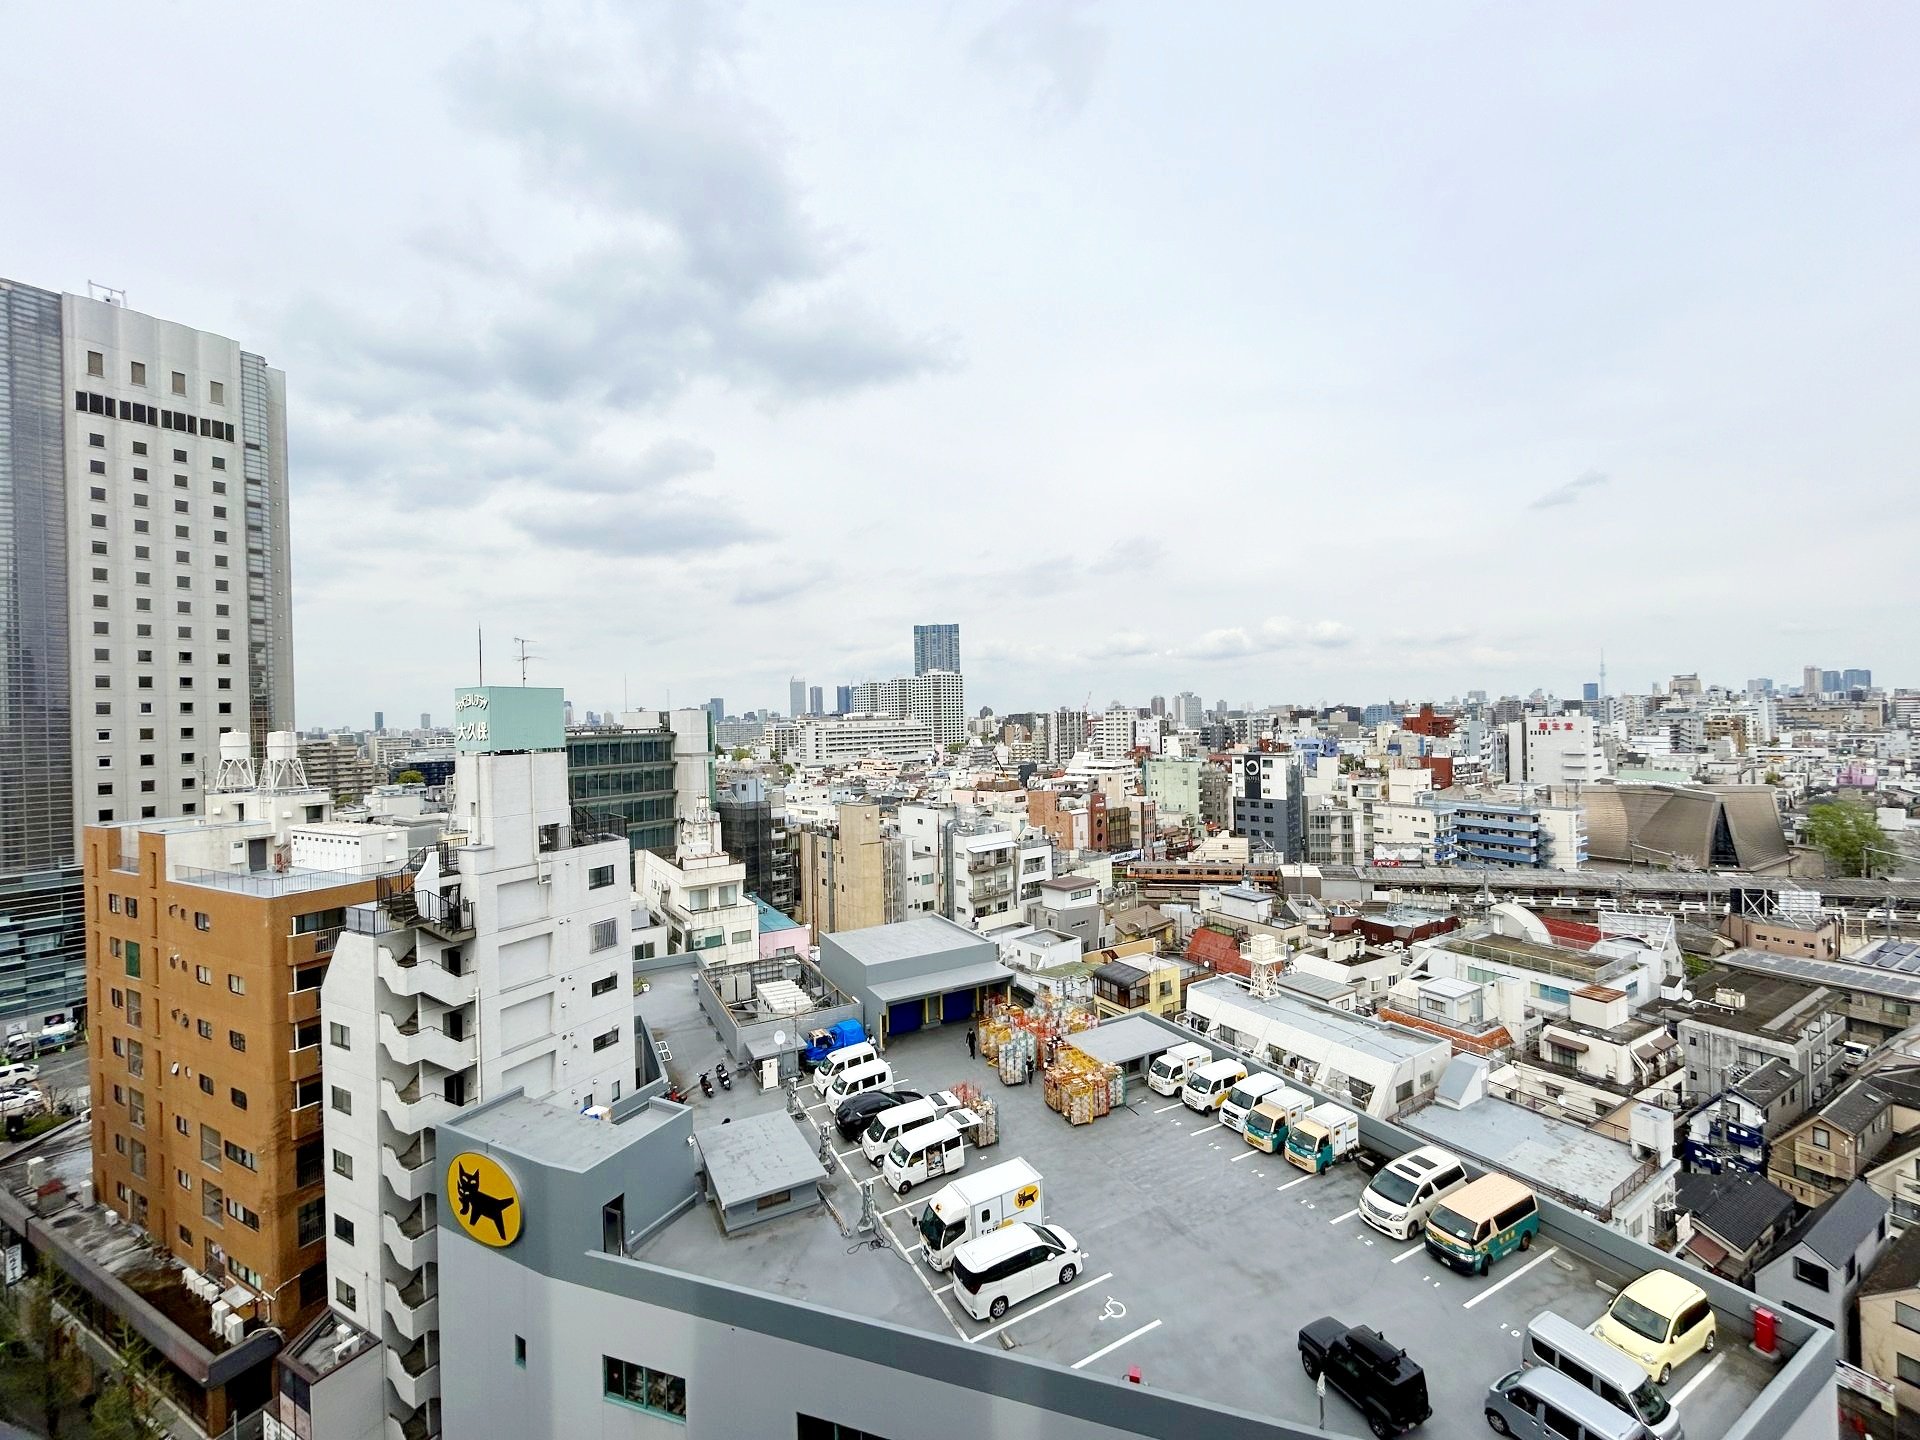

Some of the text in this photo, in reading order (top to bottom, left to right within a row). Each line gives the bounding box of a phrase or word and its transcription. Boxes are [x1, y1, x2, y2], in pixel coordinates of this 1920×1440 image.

[456, 721, 488, 741] 大久保
[1500, 1322, 1521, 1337] 10
